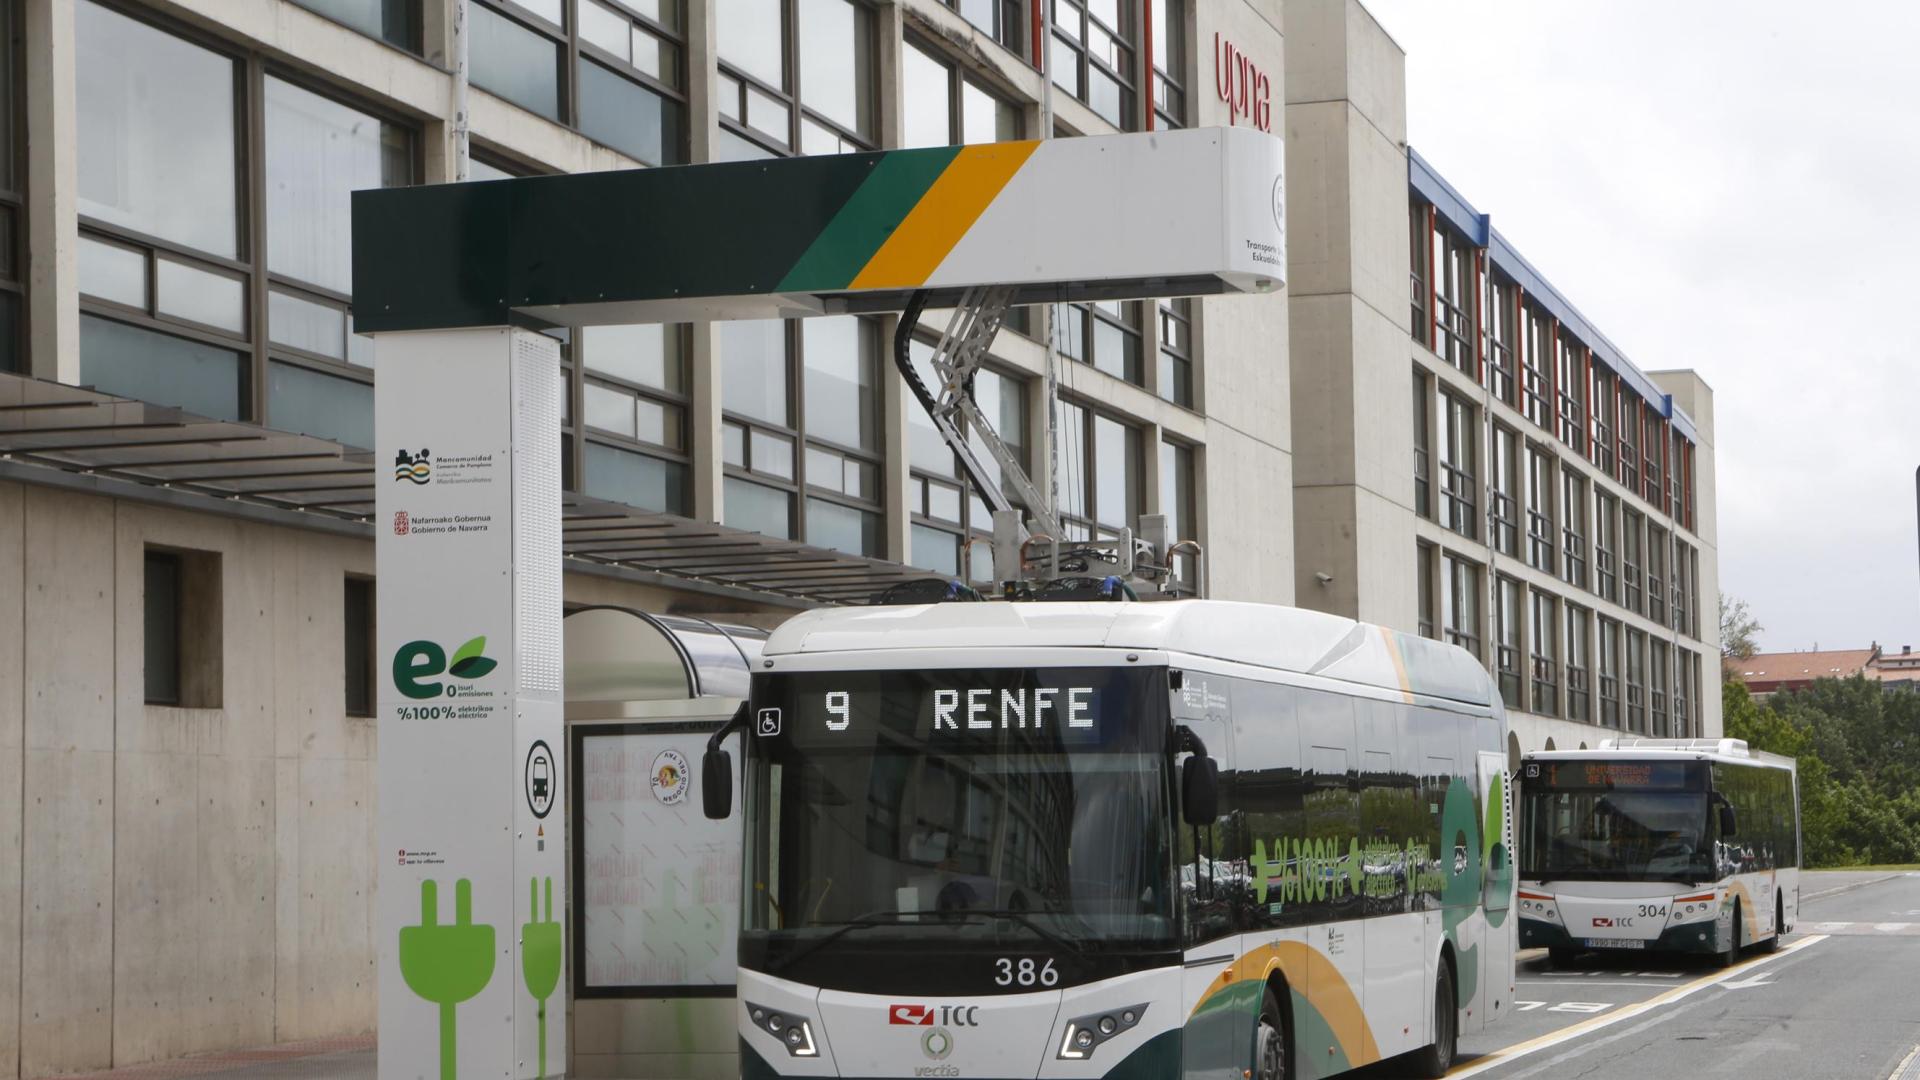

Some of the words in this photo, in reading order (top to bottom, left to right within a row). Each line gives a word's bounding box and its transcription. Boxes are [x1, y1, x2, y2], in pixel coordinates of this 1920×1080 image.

[1214, 31, 1270, 133] upna
[411, 517, 453, 525] Nafarroako
[454, 515, 491, 523] Gobernua
[411, 526, 446, 534] Gobierno
[392, 639, 447, 700] e
[446, 684, 457, 698] 0
[457, 704, 494, 713] elektrikoa
[825, 691, 850, 731] 9
[934, 687, 1094, 730] RENFE
[1638, 904, 1666, 918] 304
[1616, 917, 1633, 928] TCC
[994, 957, 1060, 987] 386
[940, 1004, 980, 1027] TCC
[913, 1064, 960, 1077] vectia
